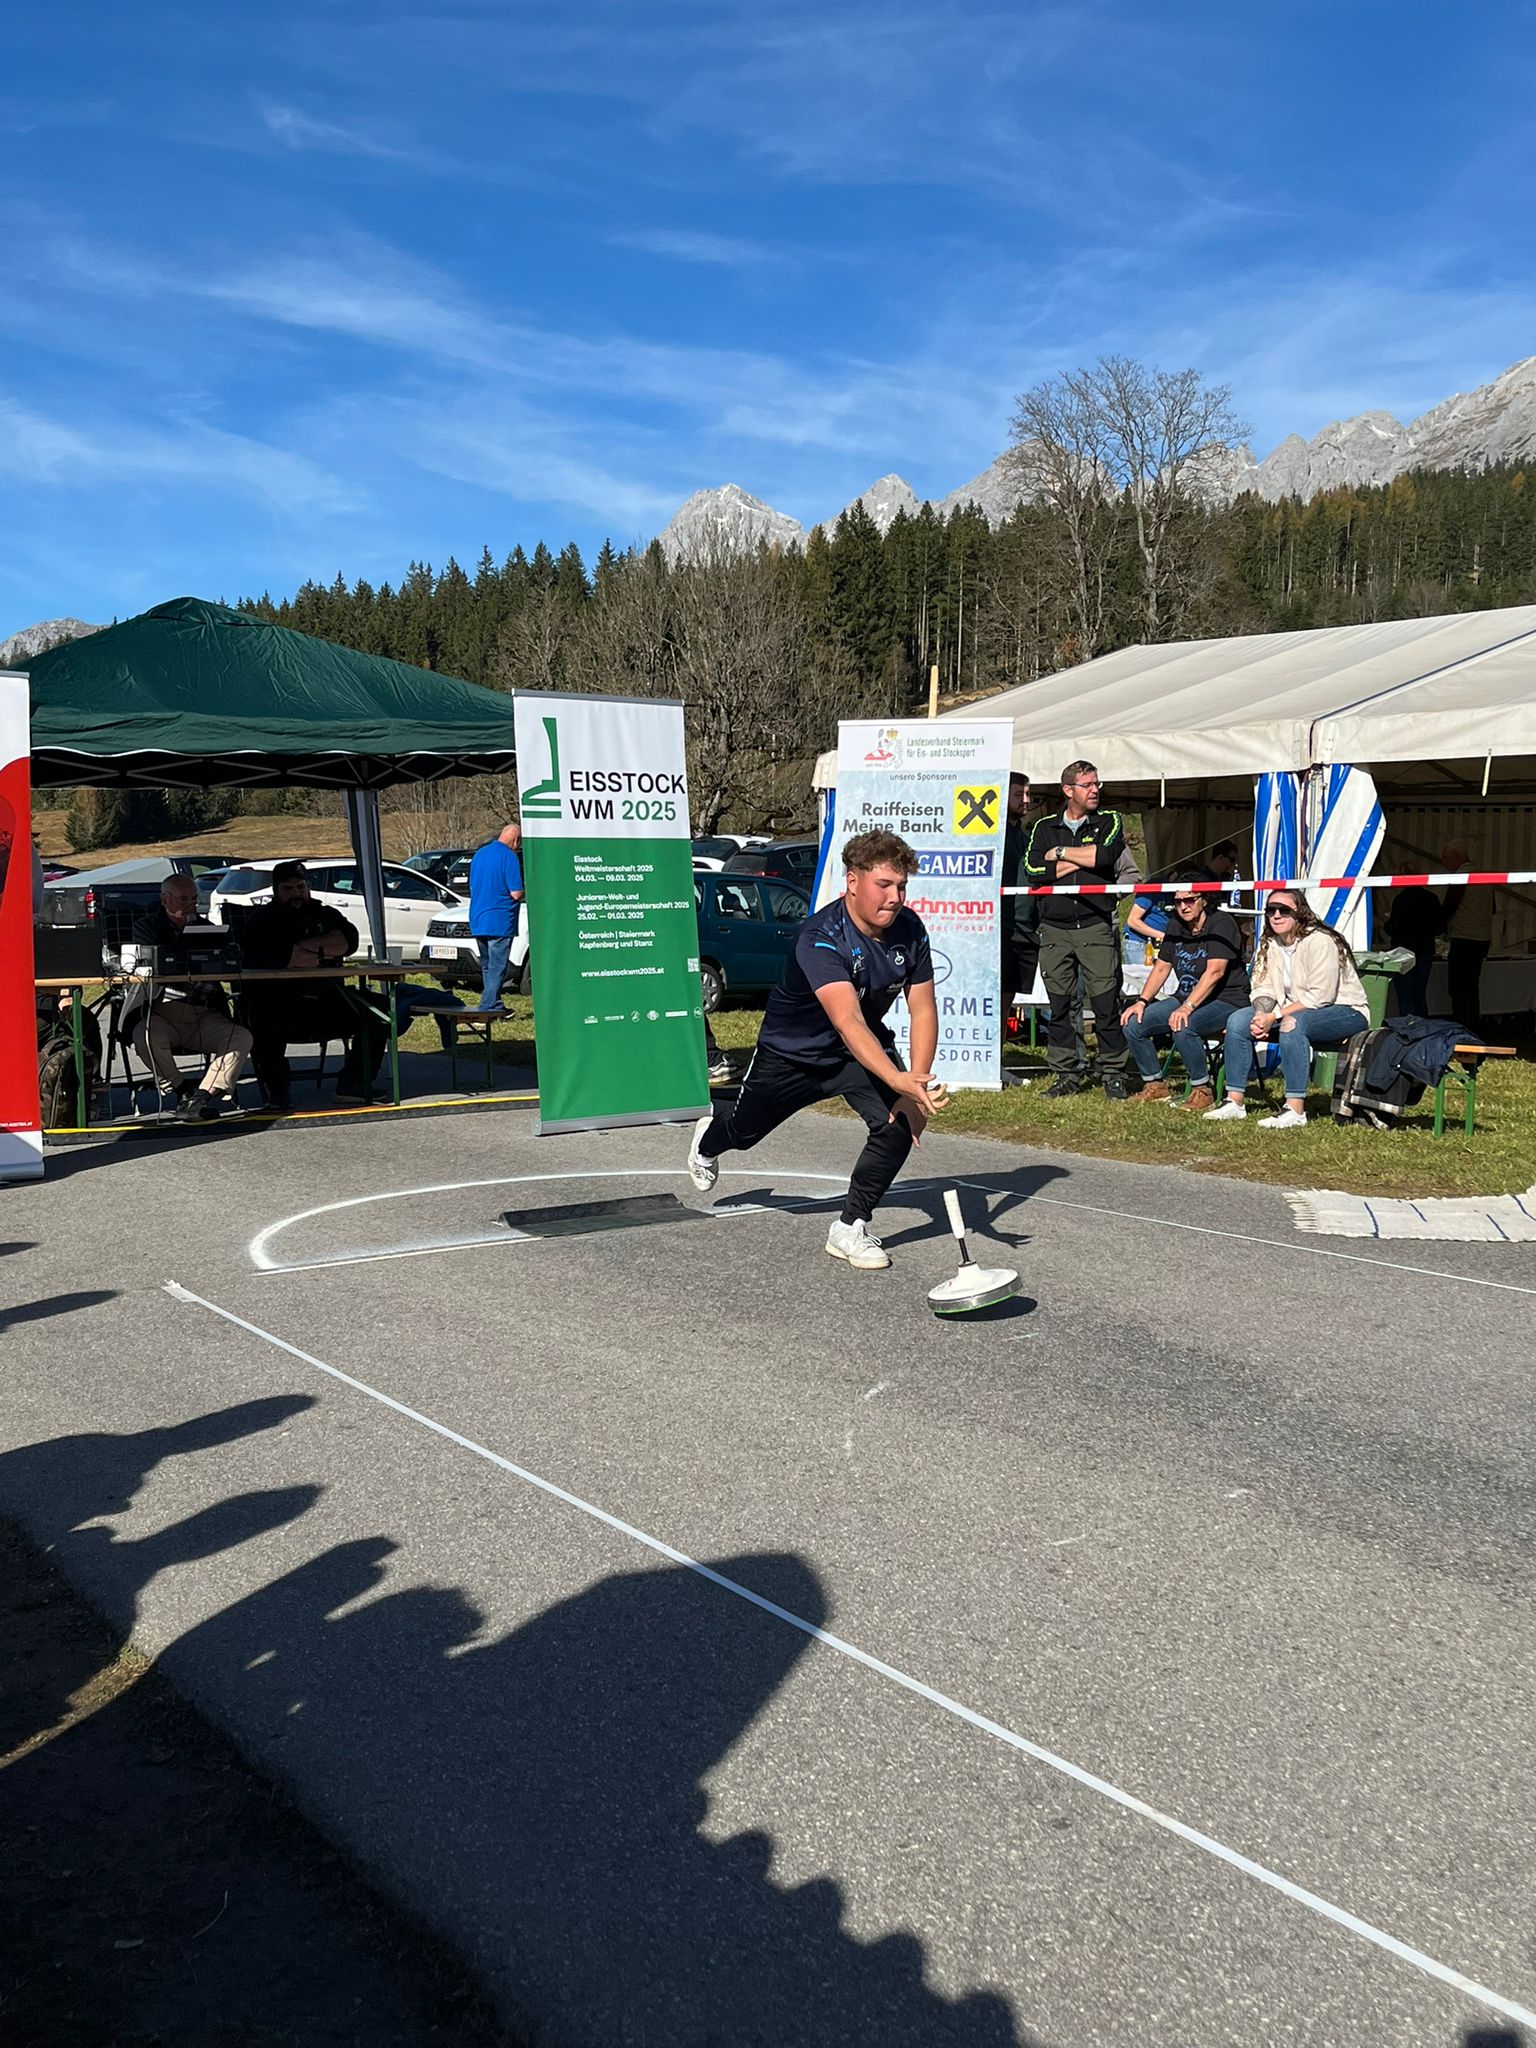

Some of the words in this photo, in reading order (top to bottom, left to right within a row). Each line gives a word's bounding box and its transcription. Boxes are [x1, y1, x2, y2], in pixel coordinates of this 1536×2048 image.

[952, 736, 985, 746] Steiermark
[930, 748, 941, 757] und
[942, 748, 976, 759] Stocksport
[916, 772, 957, 782] Sponsoren
[570, 771, 686, 794] EISSTOCK
[570, 799, 614, 820] WM
[622, 800, 676, 820] 2025
[862, 801, 944, 816] Raiffeisen
[842, 818, 894, 833] Meine
[900, 817, 944, 833] Bank
[573, 855, 603, 863] Eisstock
[637, 864, 654, 872] 2025
[575, 874, 597, 882] 04.03.
[627, 873, 644, 881] 2025
[577, 902, 673, 912] Jugend-Europameisterschaft
[674, 901, 690, 909] 2025
[906, 896, 994, 914] chmann
[577, 912, 599, 920] 25.02.
[627, 911, 645, 919] 2025
[578, 930, 614, 939] Österreich
[619, 930, 655, 938] Steiermark
[579, 941, 620, 950] Kapfenberg
[620, 940, 633, 948] und
[581, 967, 664, 977] www.eisstockwm2025.at
